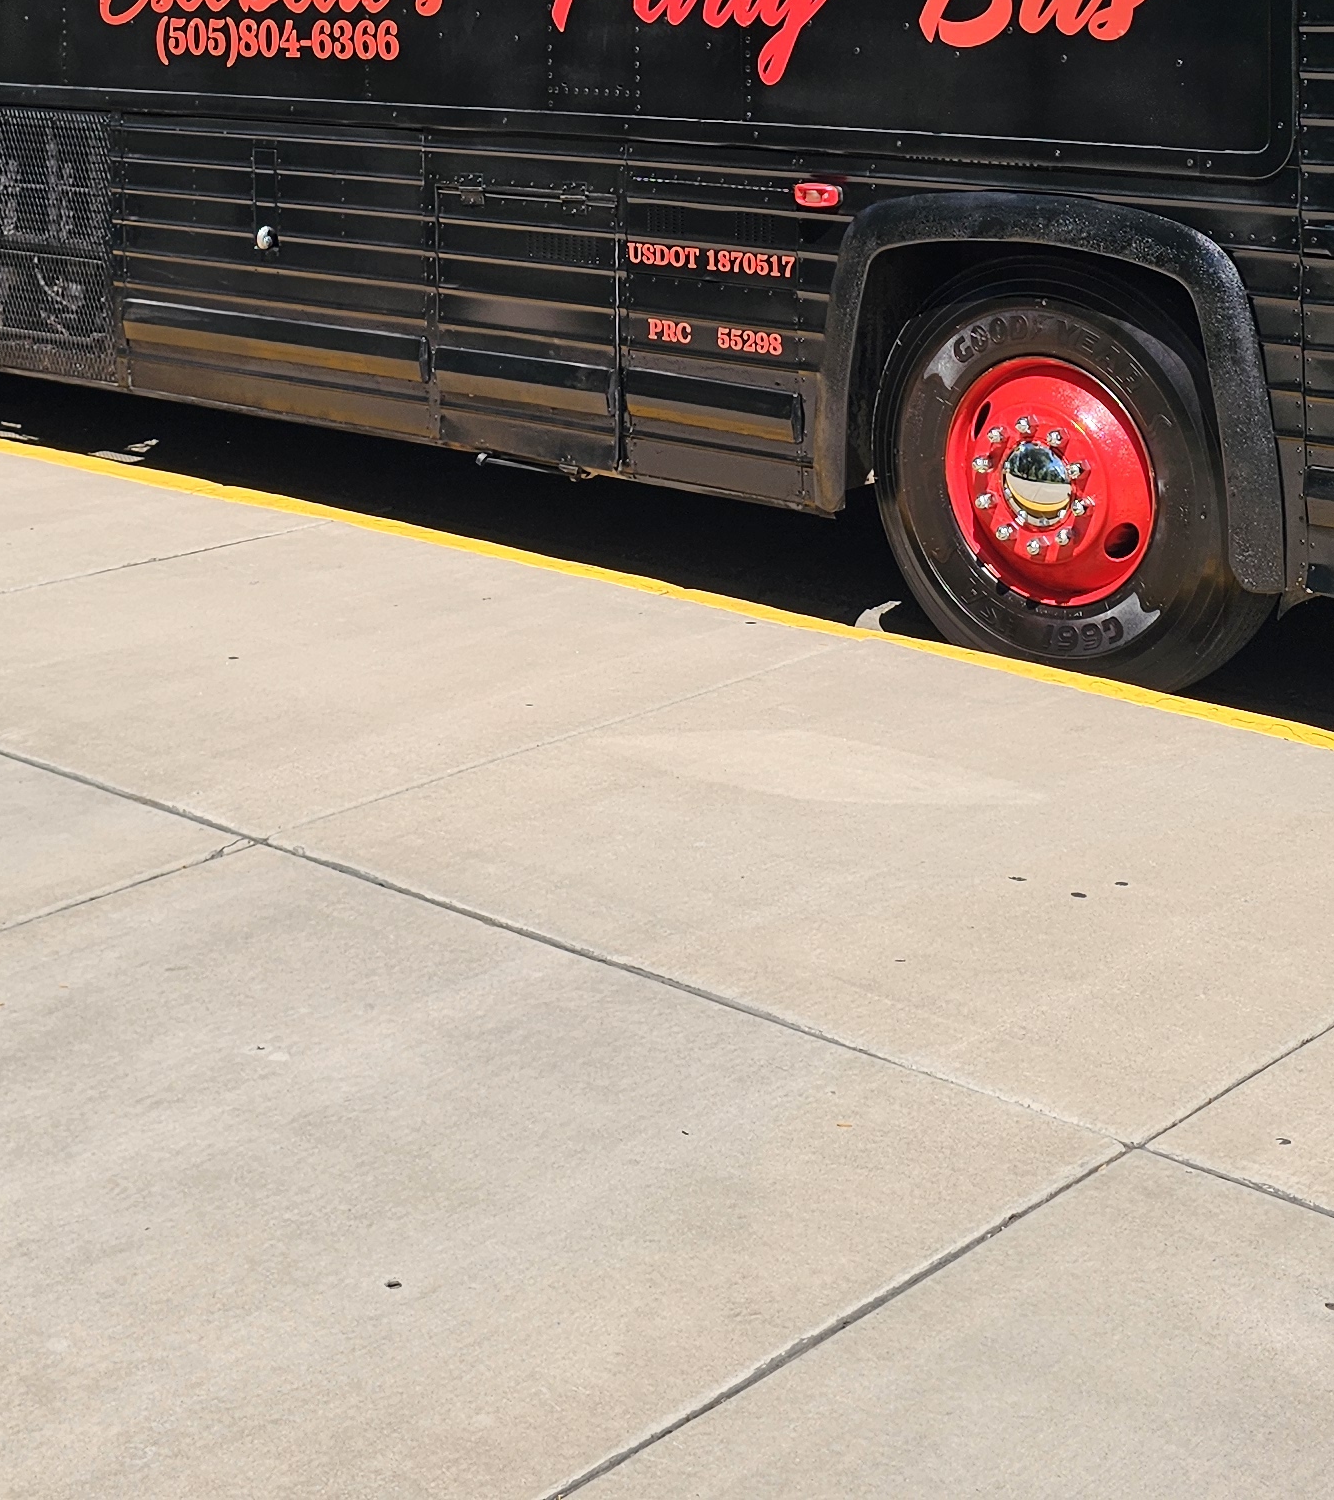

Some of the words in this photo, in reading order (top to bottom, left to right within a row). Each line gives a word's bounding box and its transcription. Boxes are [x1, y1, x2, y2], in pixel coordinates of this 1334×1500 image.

[155, 16, 400, 67] (505)804-6366
[627, 242, 700, 269] USDOT
[706, 250, 796, 277] 1870517
[647, 318, 692, 344] PRC
[717, 327, 783, 356] 55298
